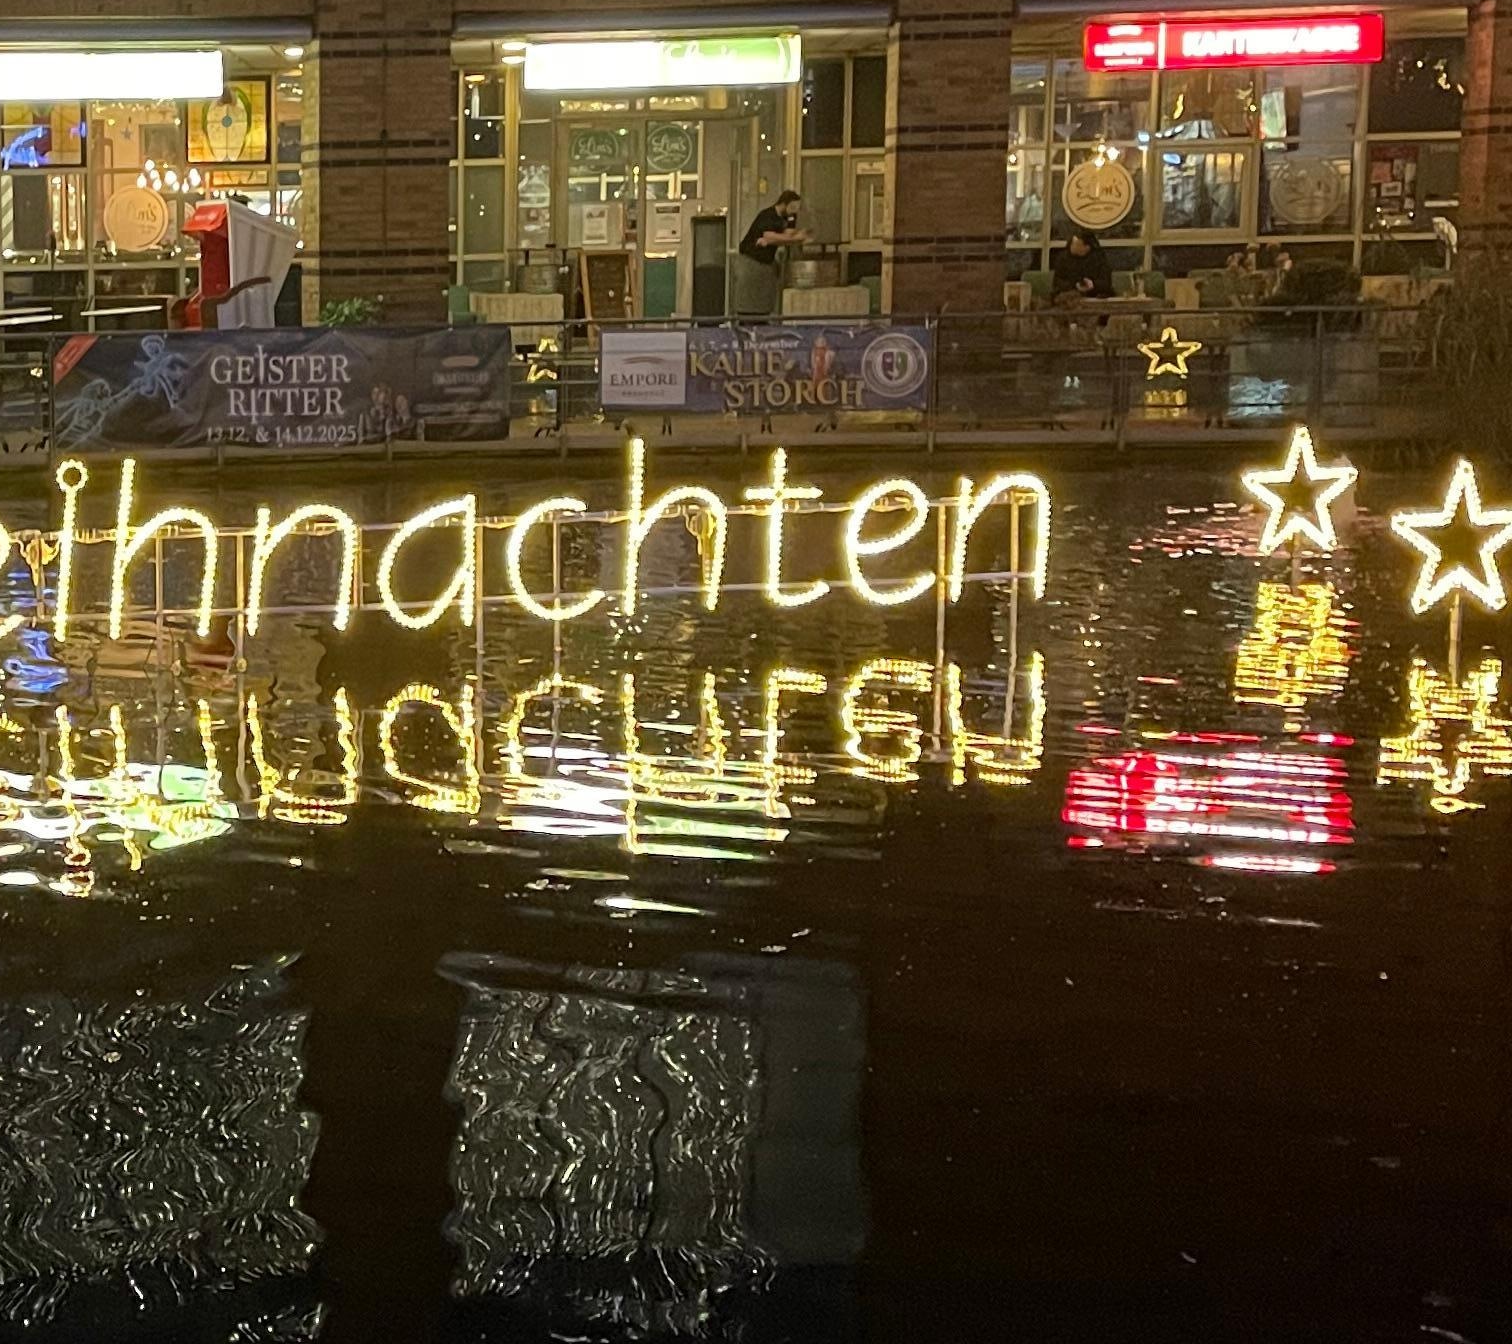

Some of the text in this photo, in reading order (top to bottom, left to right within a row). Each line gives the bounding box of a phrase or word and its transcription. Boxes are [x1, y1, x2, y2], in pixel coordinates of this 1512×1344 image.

[210, 345, 352, 386] GEISTER
[609, 372, 678, 387] EMPORE
[228, 387, 345, 424] RITTER
[724, 376, 866, 407] STORCH
[255, 425, 270, 443] &
